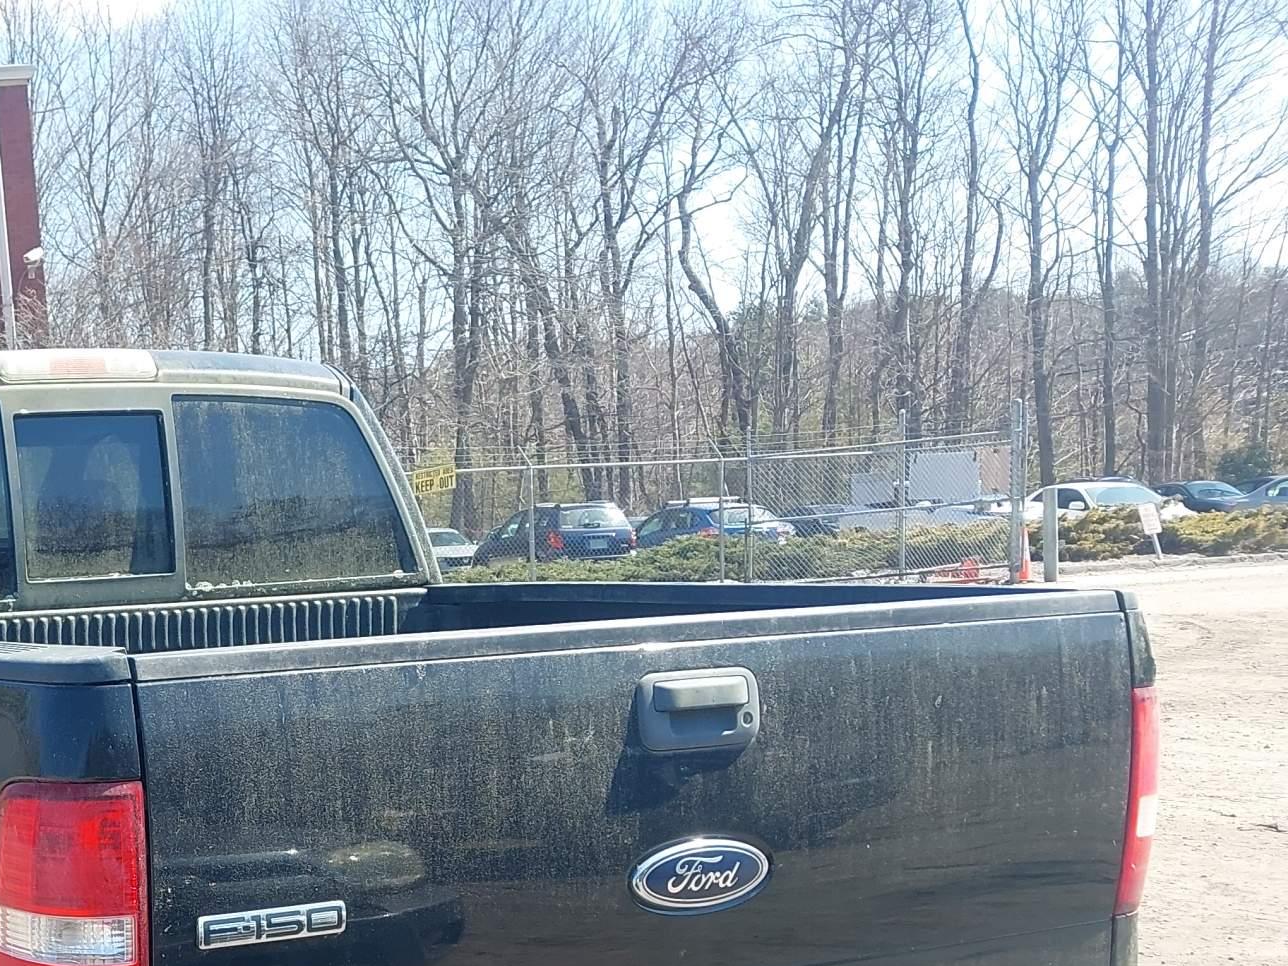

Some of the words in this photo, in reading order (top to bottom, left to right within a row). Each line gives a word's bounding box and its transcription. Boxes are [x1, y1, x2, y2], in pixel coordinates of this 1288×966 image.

[415, 479, 434, 494] KEEP
[439, 475, 454, 489] OUT
[667, 855, 741, 894] Ford
[202, 904, 344, 947] F-150
